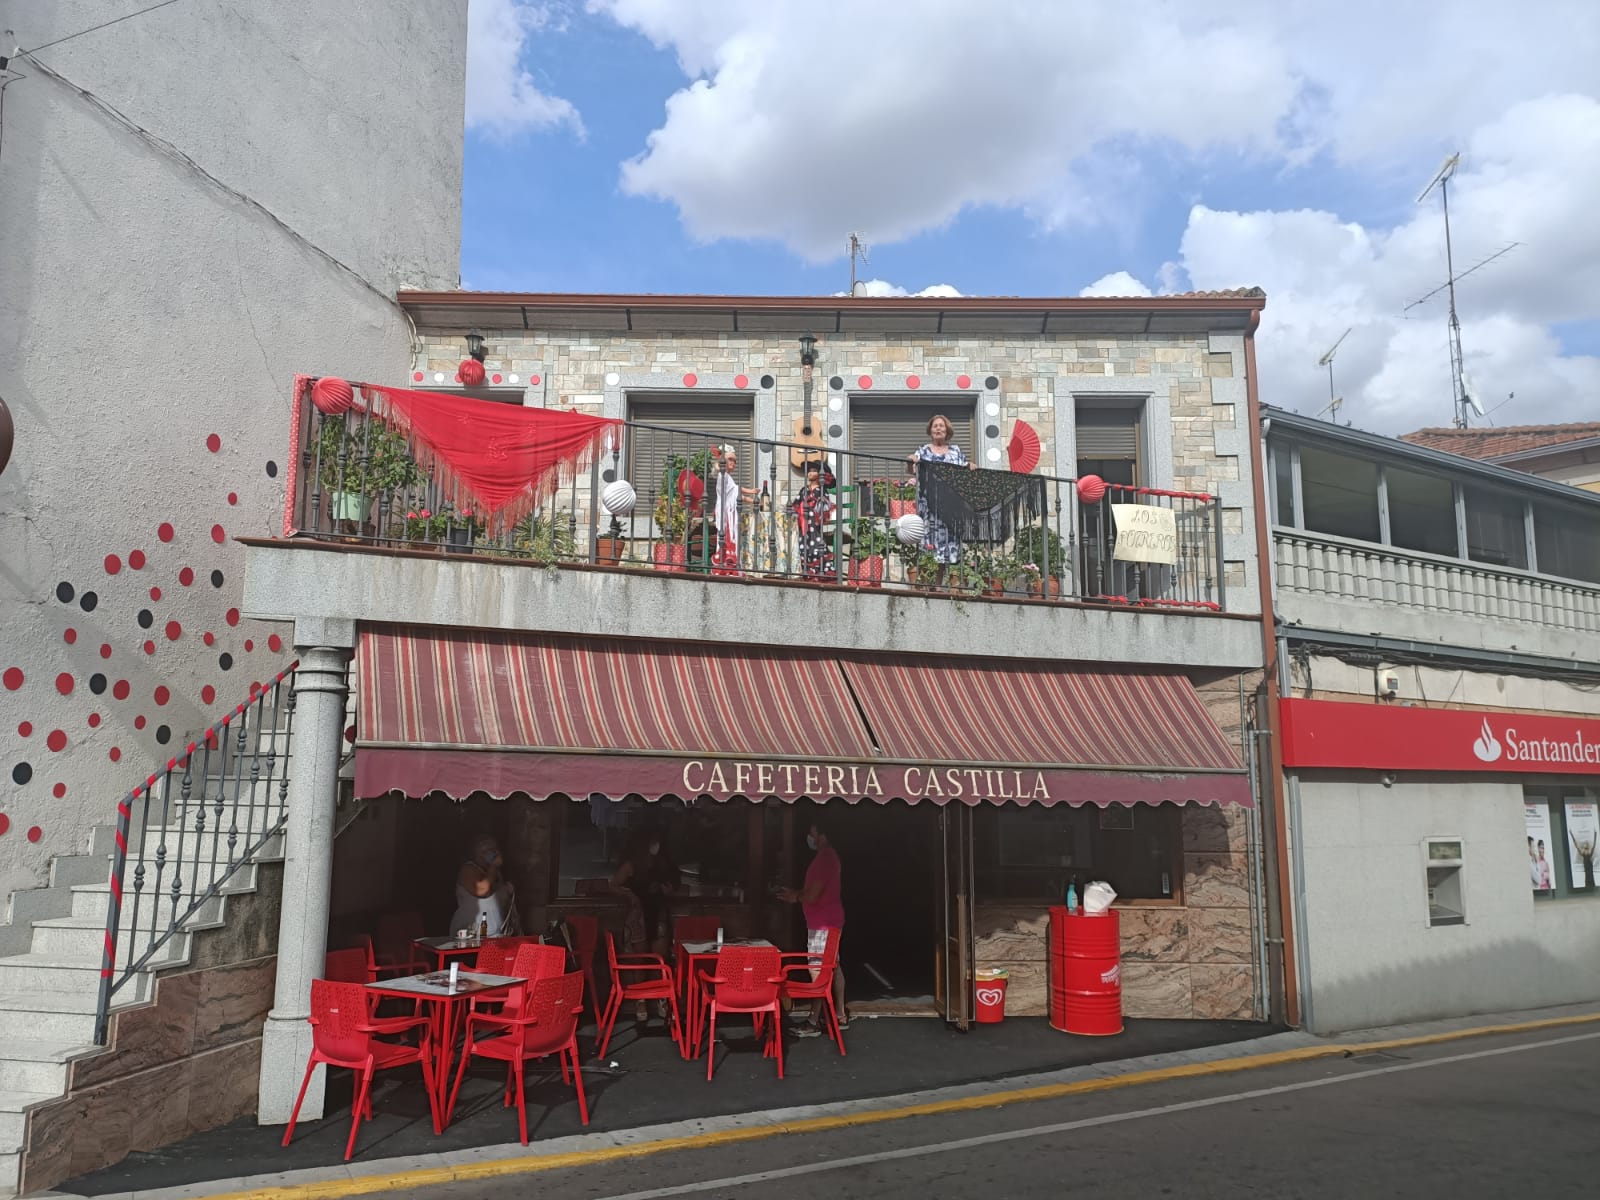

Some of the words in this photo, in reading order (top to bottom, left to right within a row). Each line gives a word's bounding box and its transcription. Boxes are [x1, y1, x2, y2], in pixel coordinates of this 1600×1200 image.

[1130, 508, 1158, 525] LOS
[1505, 728, 1600, 764] Santander
[682, 760, 885, 796] CAFETERIA
[903, 766, 1051, 799] CASTILLA
